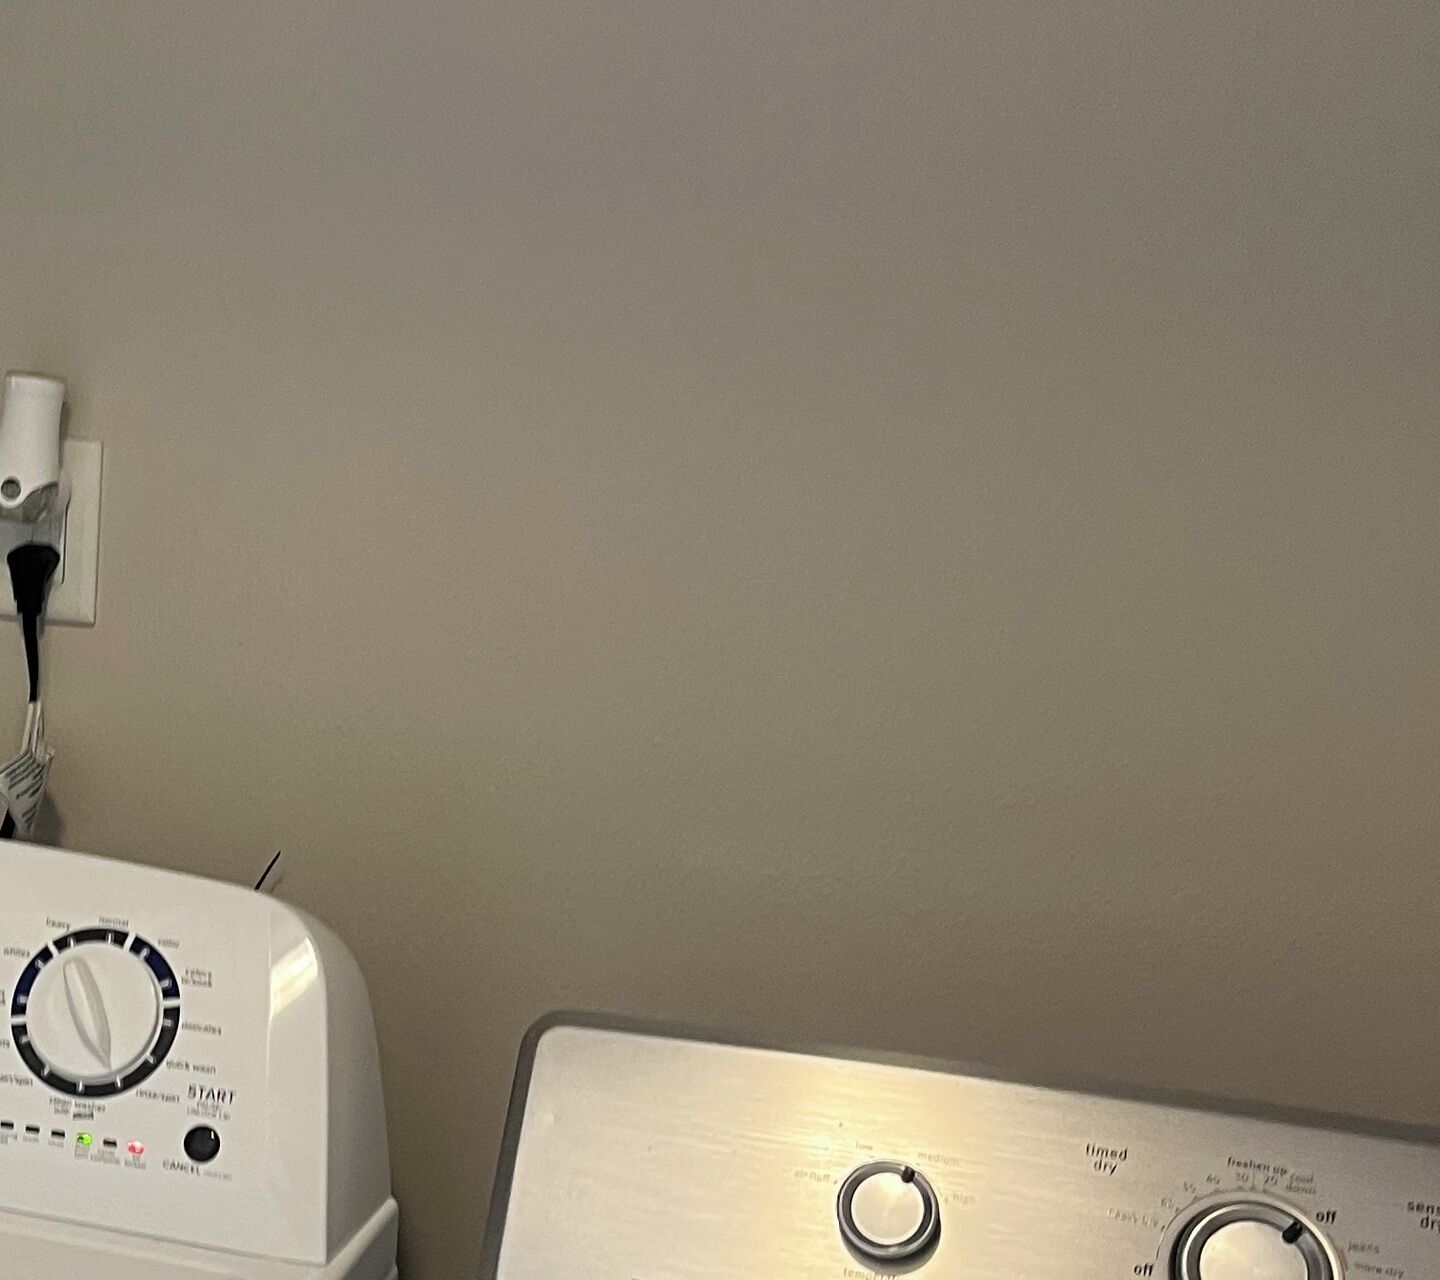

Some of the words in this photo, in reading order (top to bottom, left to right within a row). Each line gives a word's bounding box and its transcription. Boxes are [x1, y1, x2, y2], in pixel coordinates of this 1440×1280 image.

[187, 1083, 236, 1106] START
[1085, 1142, 1128, 1162] timed
[1093, 1159, 1118, 1176] dry
[1226, 1156, 1270, 1173] freshen
[1315, 1209, 1338, 1226] off
[1133, 1262, 1155, 1278] off
